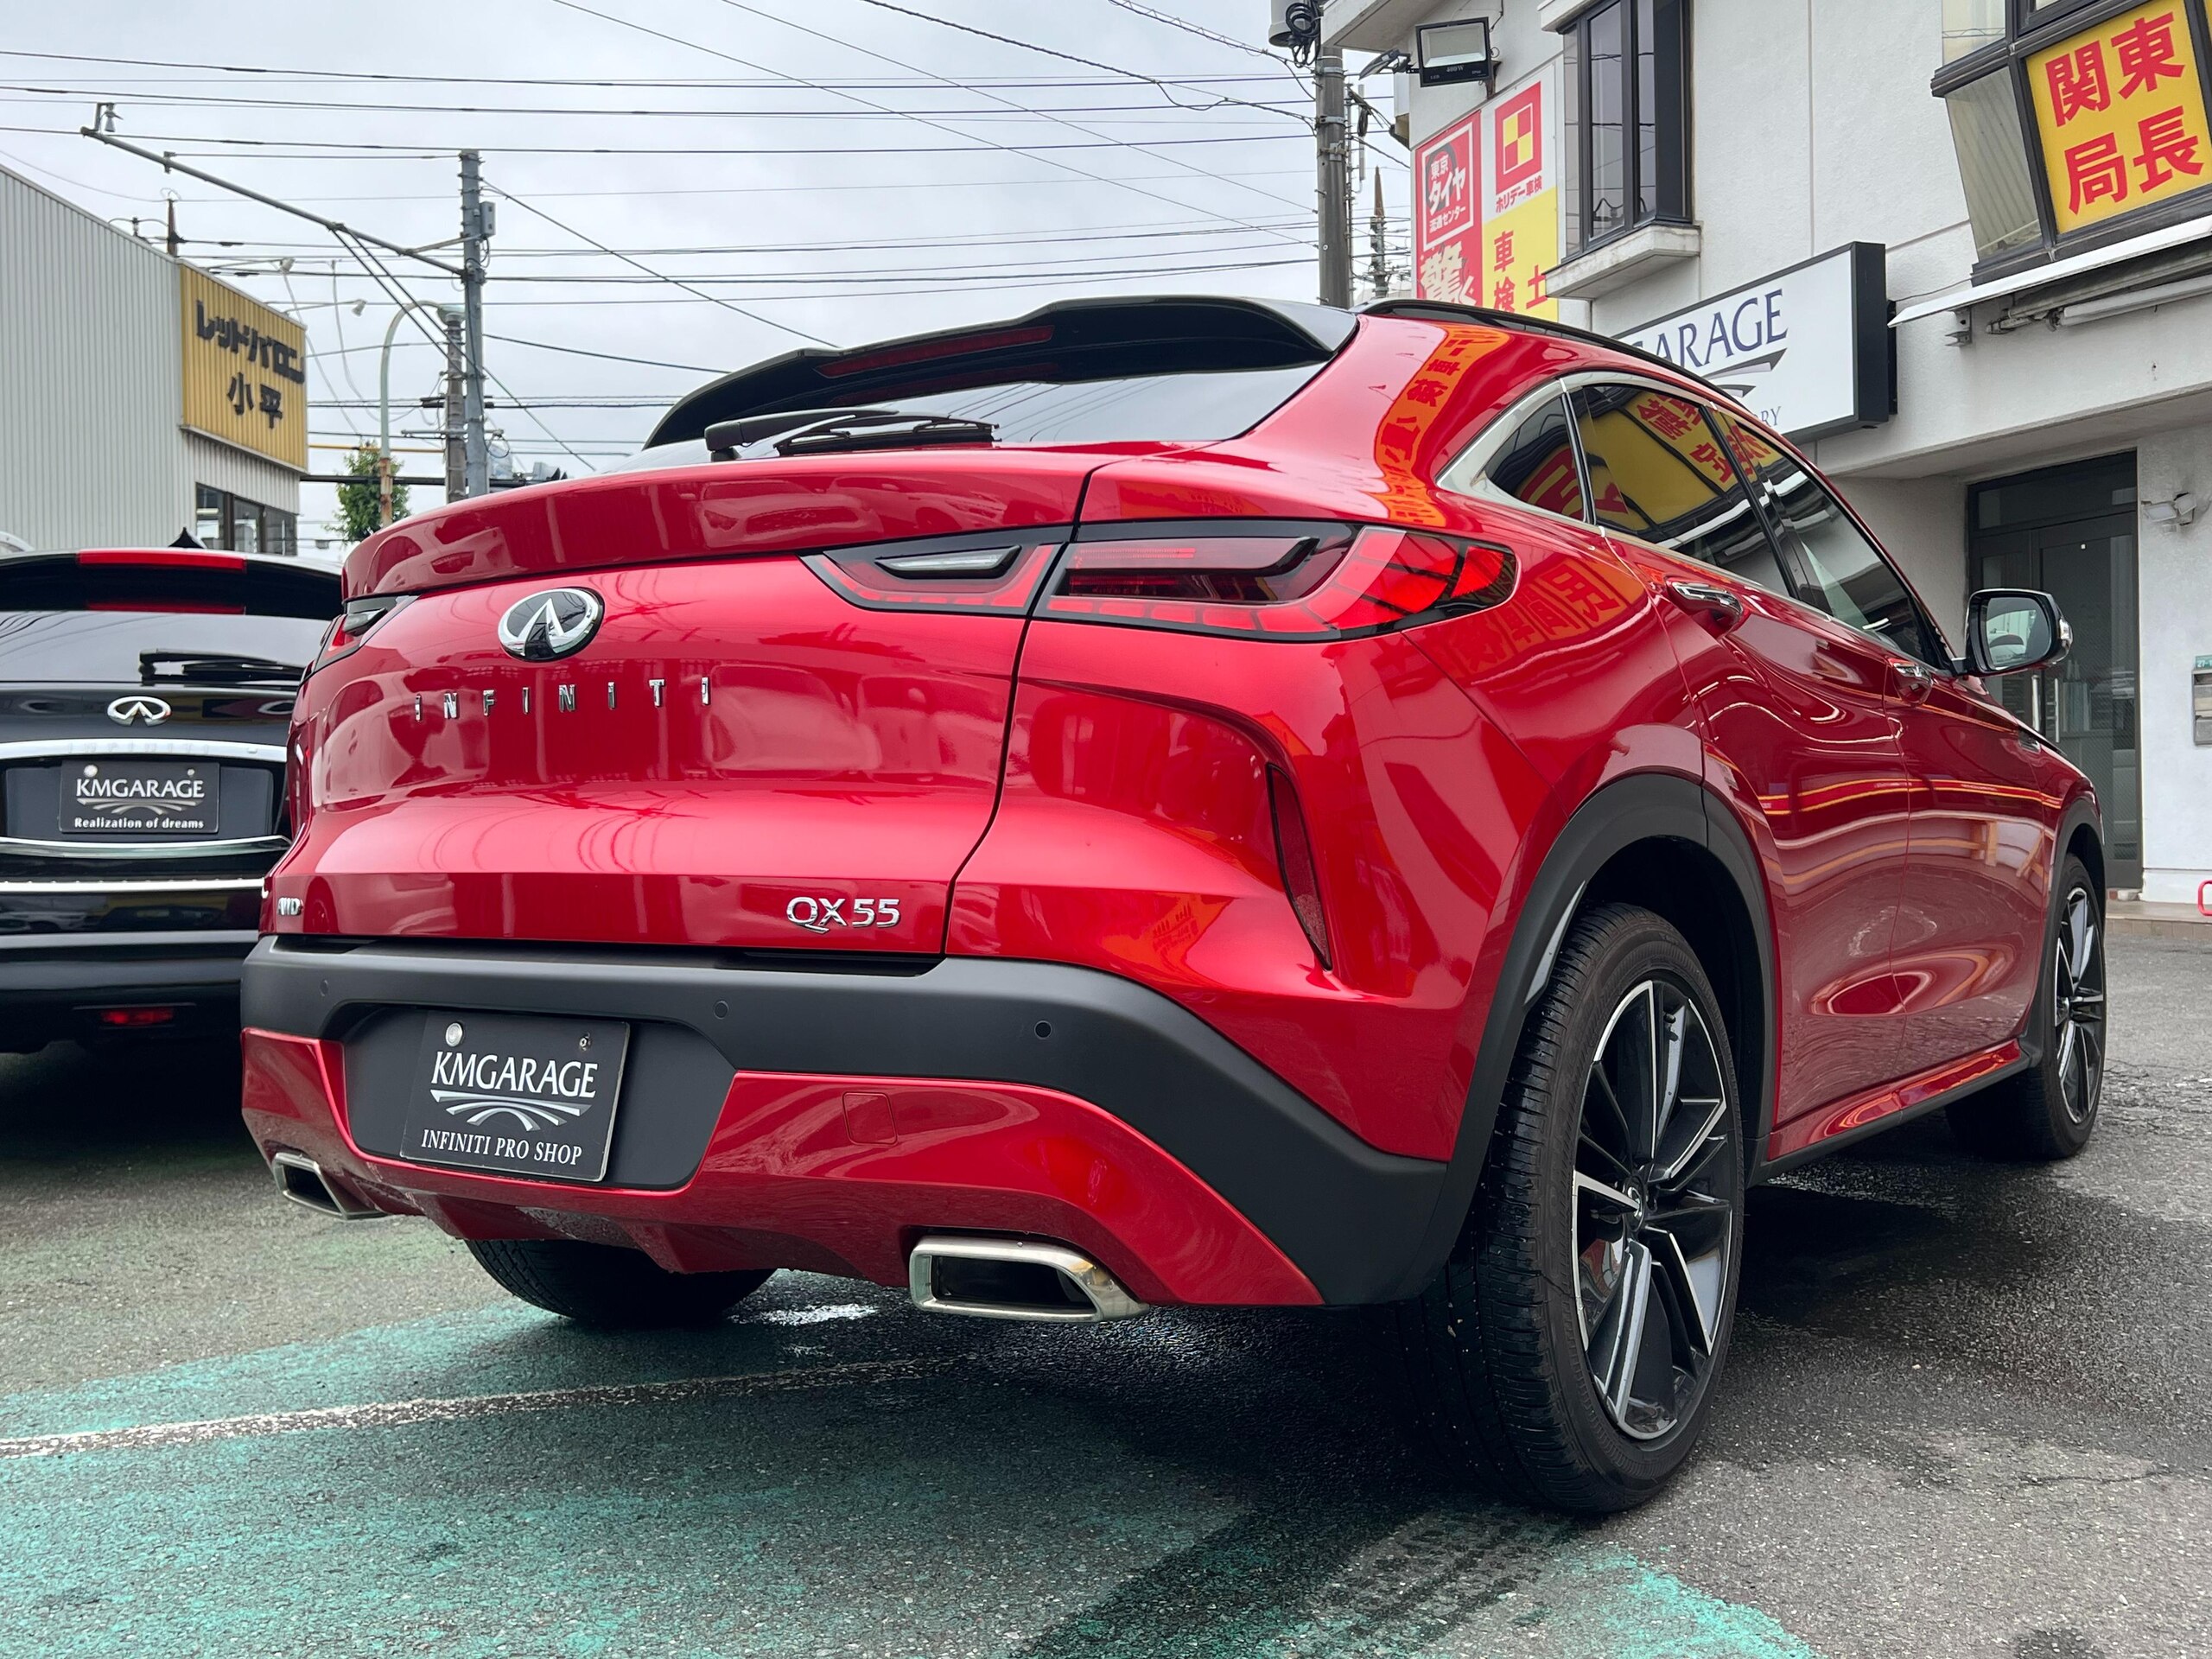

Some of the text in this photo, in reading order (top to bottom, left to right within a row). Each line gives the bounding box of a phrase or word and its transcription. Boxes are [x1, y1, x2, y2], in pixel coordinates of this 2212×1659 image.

[2044, 10, 2186, 128] 関東
[1430, 154, 1449, 181] 東京
[2063, 105, 2205, 216] 局長
[1428, 166, 1466, 216] タイヤ
[1496, 175, 1542, 213] ホリデー車検
[196, 299, 305, 385] レッドバロン
[1632, 288, 1789, 368] ARAGE
[226, 372, 283, 429] 小平
[415, 677, 710, 721] INFINITI
[75, 779, 206, 798] KMGARAGE
[74, 817, 204, 829] Realization of dreams
[430, 1051, 599, 1098] KMGARAGE
[421, 1128, 582, 1166] INFINITI PRO SHOP
